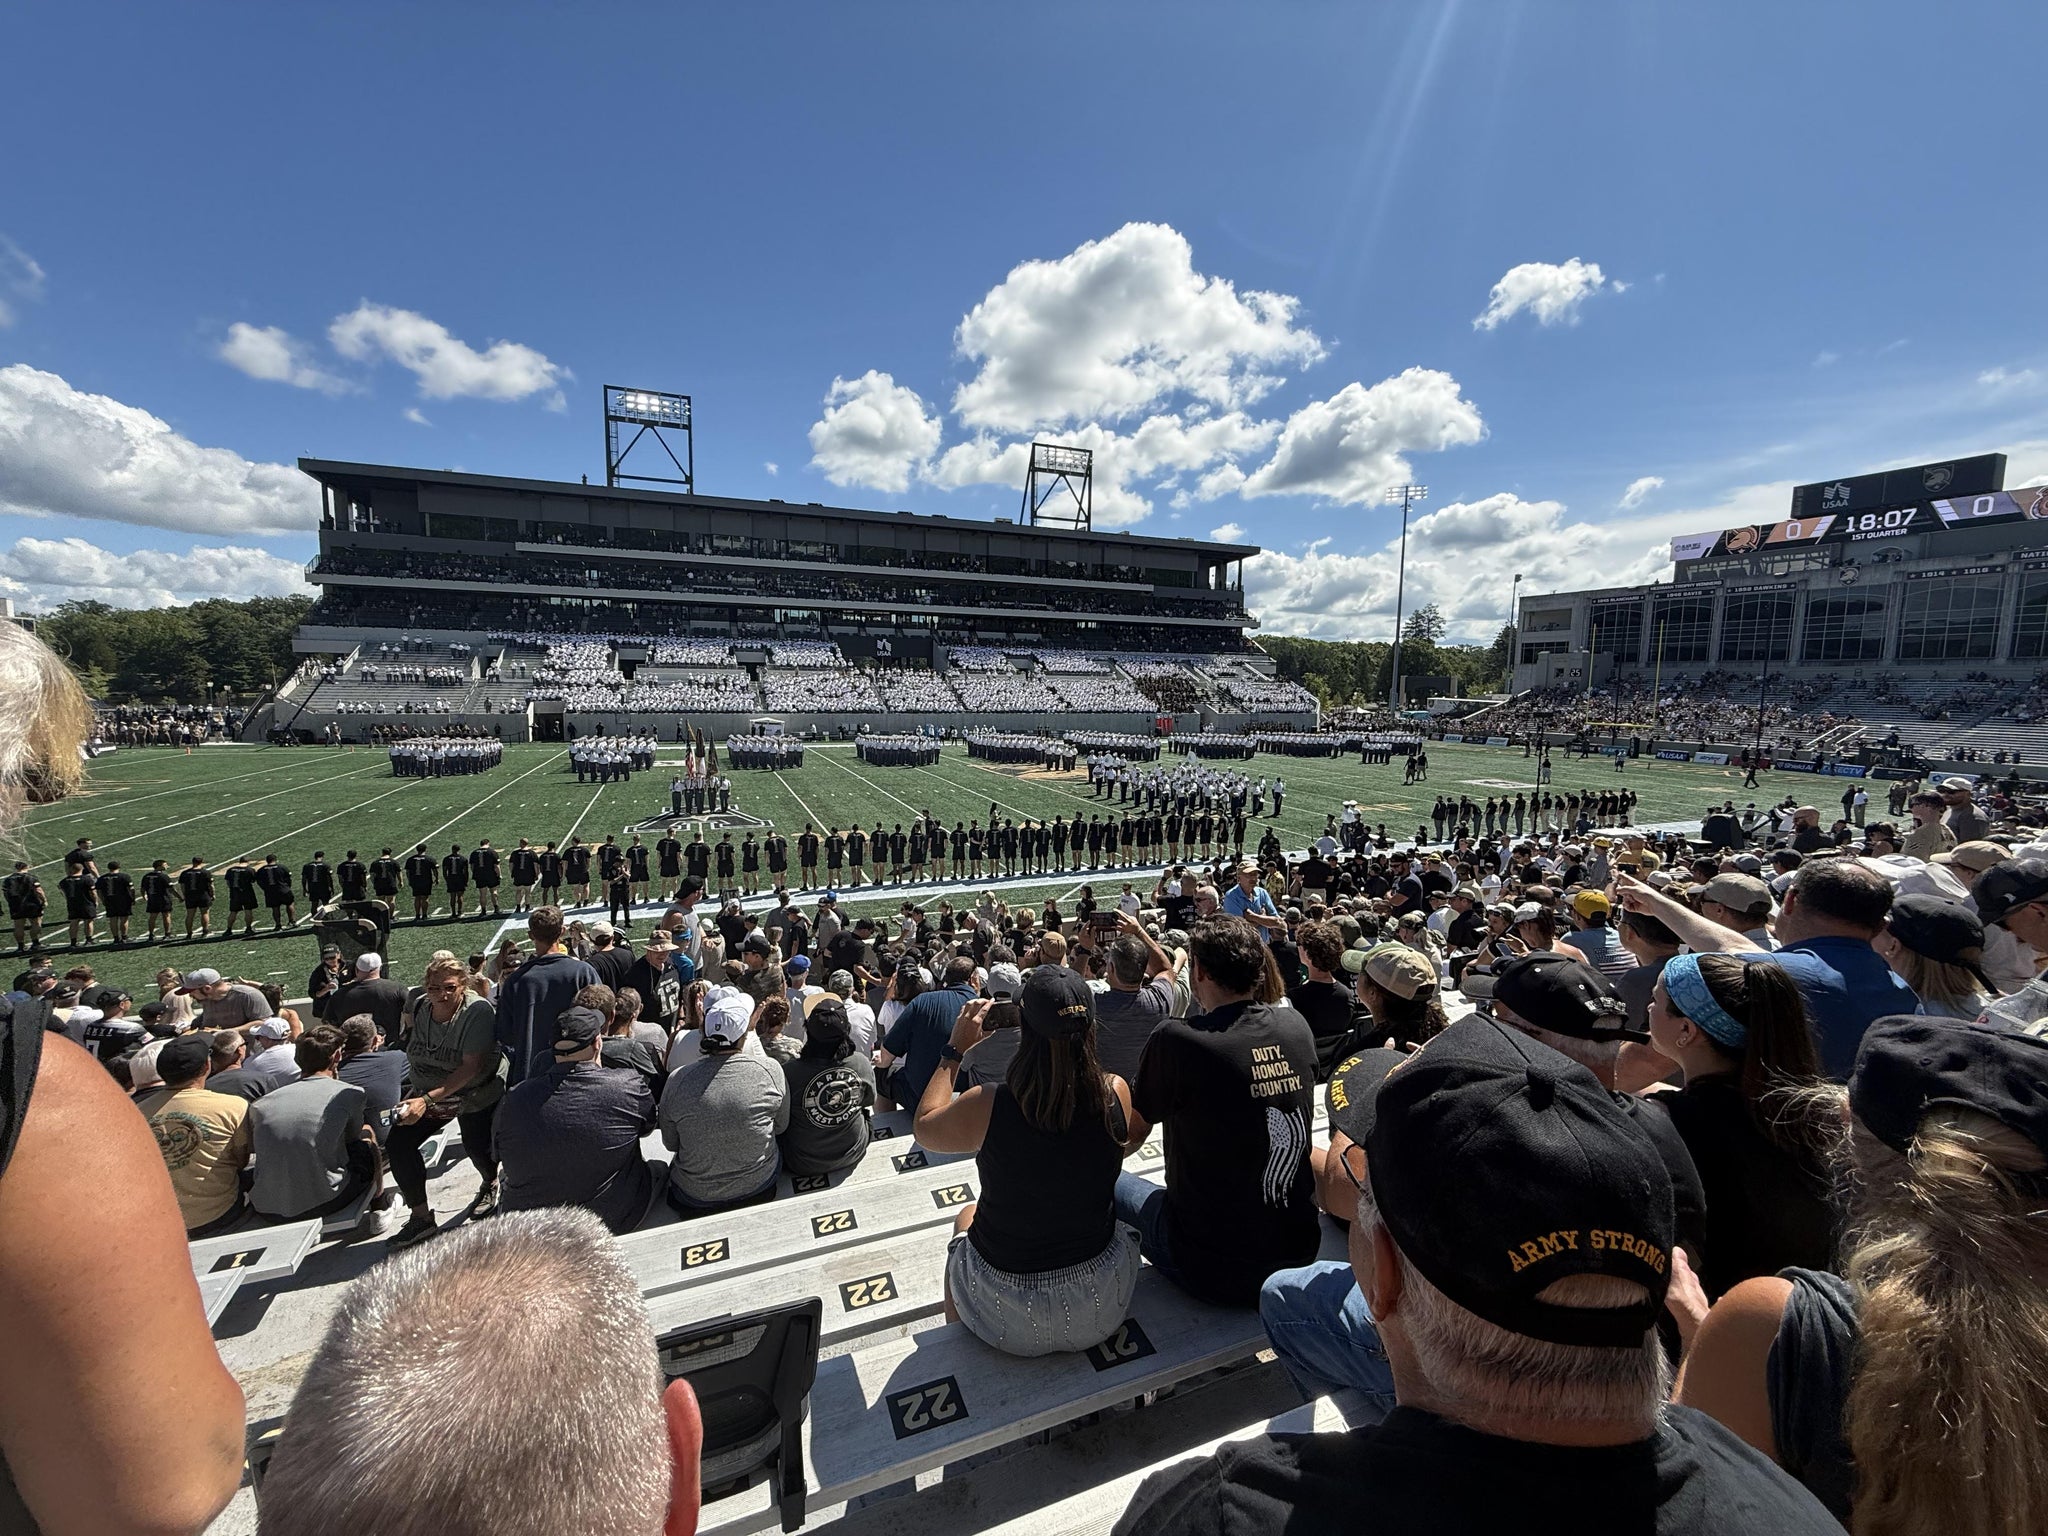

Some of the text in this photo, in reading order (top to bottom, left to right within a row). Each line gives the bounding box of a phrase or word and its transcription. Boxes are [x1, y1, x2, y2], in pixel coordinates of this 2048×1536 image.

[1822, 499, 1849, 509] USAA
[1972, 496, 1994, 516] 0
[1785, 522, 1802, 539] 0
[1845, 508, 1918, 533] 18:07
[1851, 528, 1908, 541] 1ST QUARTER
[2020, 551, 2048, 559] NATI
[1570, 669, 1581, 677] 25
[1665, 752, 1685, 760] USAA
[657, 981, 680, 1017] 12
[1251, 1045, 1285, 1063] DUTY.
[817, 1071, 855, 1089] ARMY
[1251, 1061, 1294, 1081] HONOR.
[1250, 1075, 1303, 1099] COUNTRY.
[1330, 1079, 1350, 1112] ARMY
[810, 1107, 834, 1125] WEST
[938, 1186, 968, 1205] 21
[816, 1212, 852, 1234] 22
[685, 1241, 724, 1266] 23
[1507, 1229, 1667, 1275] ARMY STRONG
[847, 1276, 892, 1308] 22
[897, 1383, 958, 1430] 22
